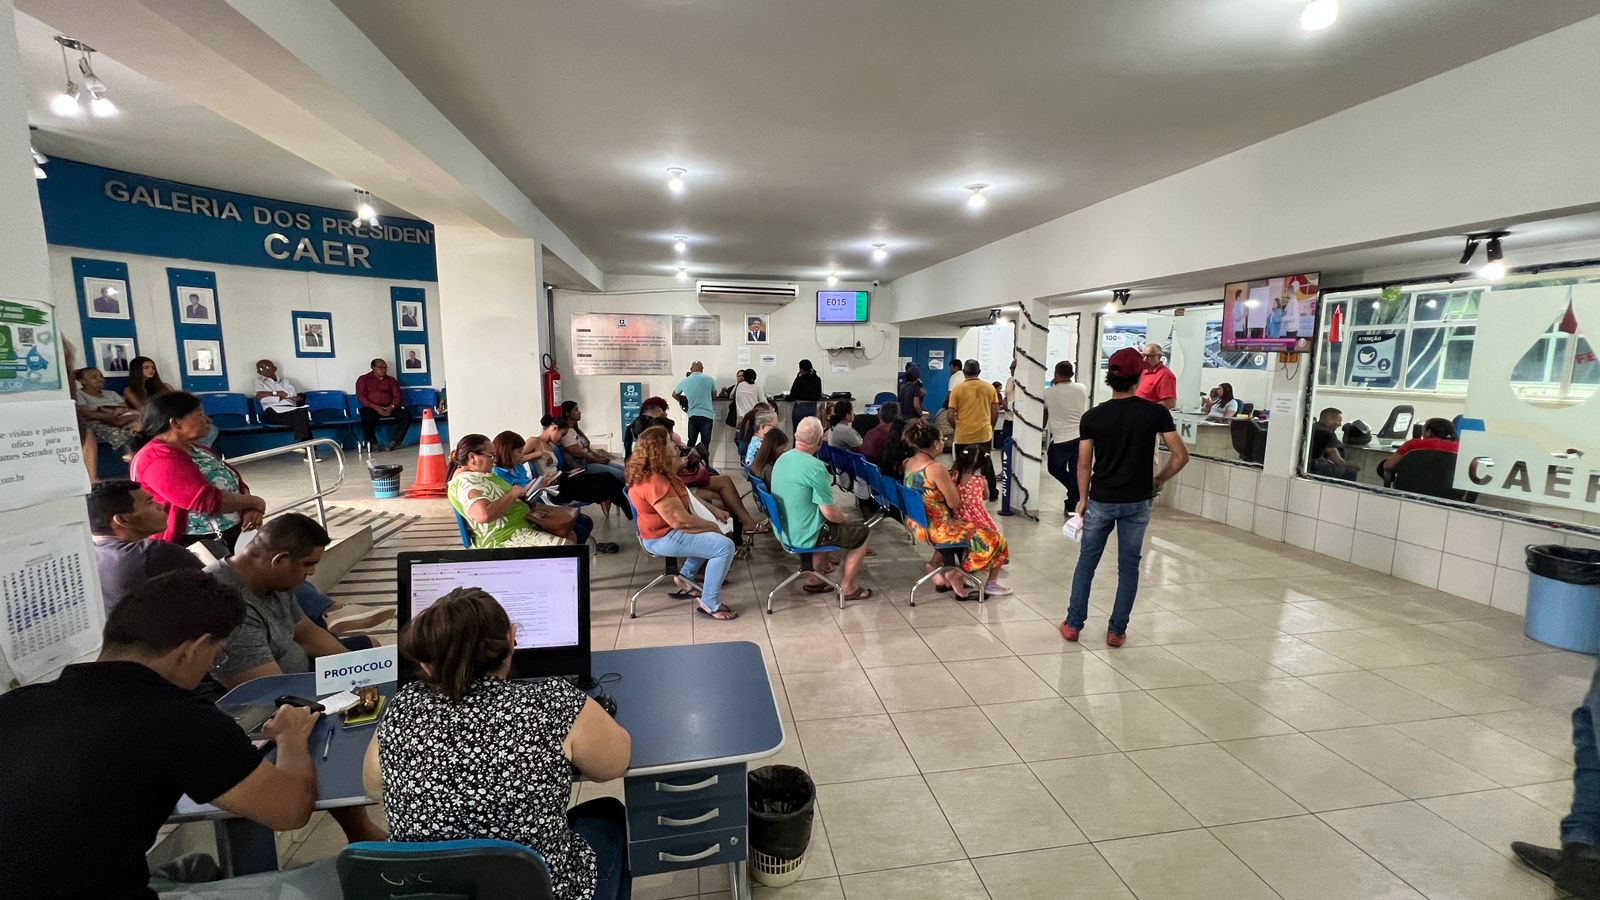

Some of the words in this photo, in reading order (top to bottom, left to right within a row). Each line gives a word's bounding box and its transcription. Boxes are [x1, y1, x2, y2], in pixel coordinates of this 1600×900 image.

[104, 180, 242, 222] GALERIA
[253, 206, 312, 231] DOS
[322, 217, 434, 245] PRESIDEN
[264, 233, 372, 269] CAER
[826, 298, 847, 306] E015
[45, 437, 61, 446] para
[56, 445, 72, 454] para
[324, 659, 393, 679] PROTOCOLO
